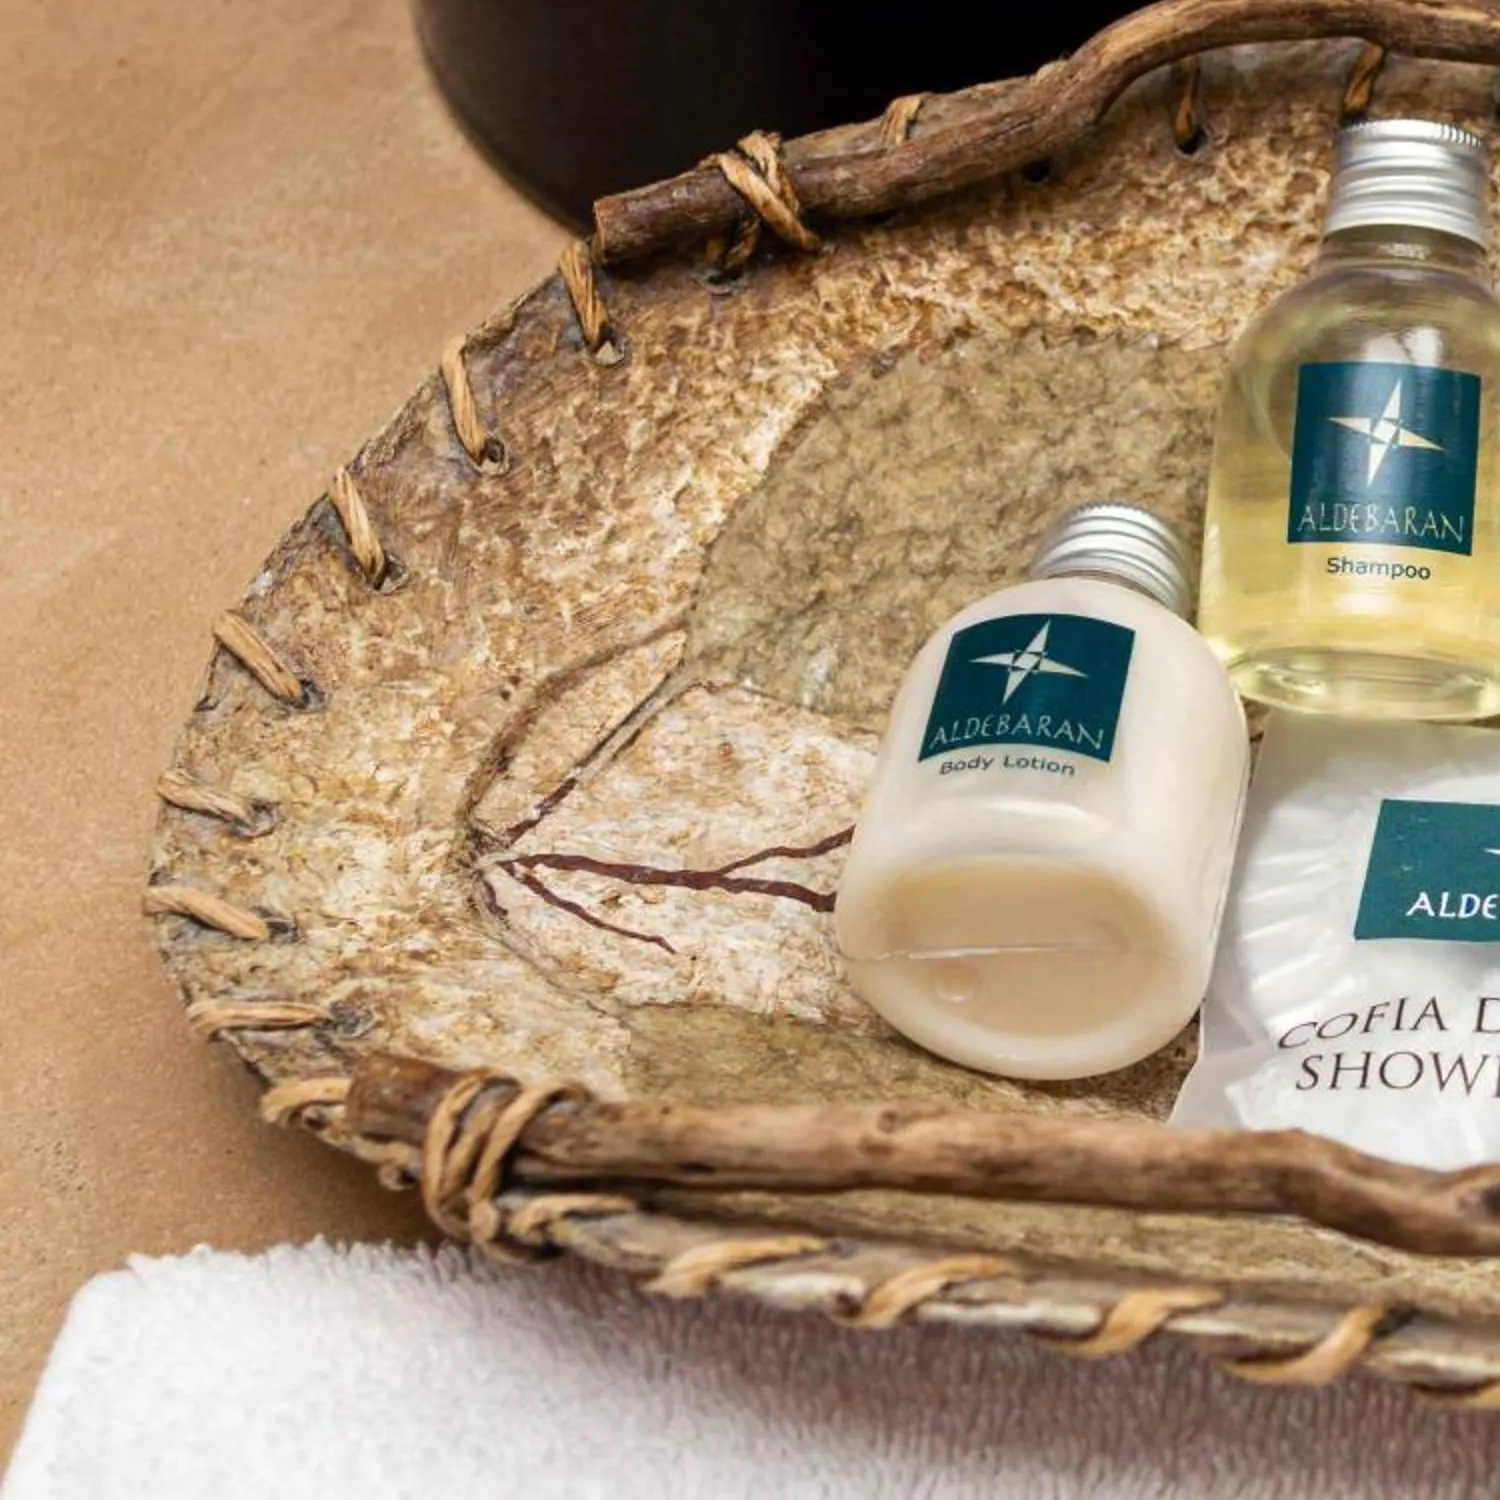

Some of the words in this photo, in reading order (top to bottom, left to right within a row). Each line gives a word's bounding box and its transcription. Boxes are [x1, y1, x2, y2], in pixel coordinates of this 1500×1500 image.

[1297, 501, 1464, 543] ALDEBARAN
[1327, 557, 1431, 580] Shampoo
[929, 713, 1103, 749] ALDEBARAN
[939, 755, 994, 775] Body
[1003, 755, 1075, 776] Lotion
[1278, 995, 1448, 1049] COFIA
